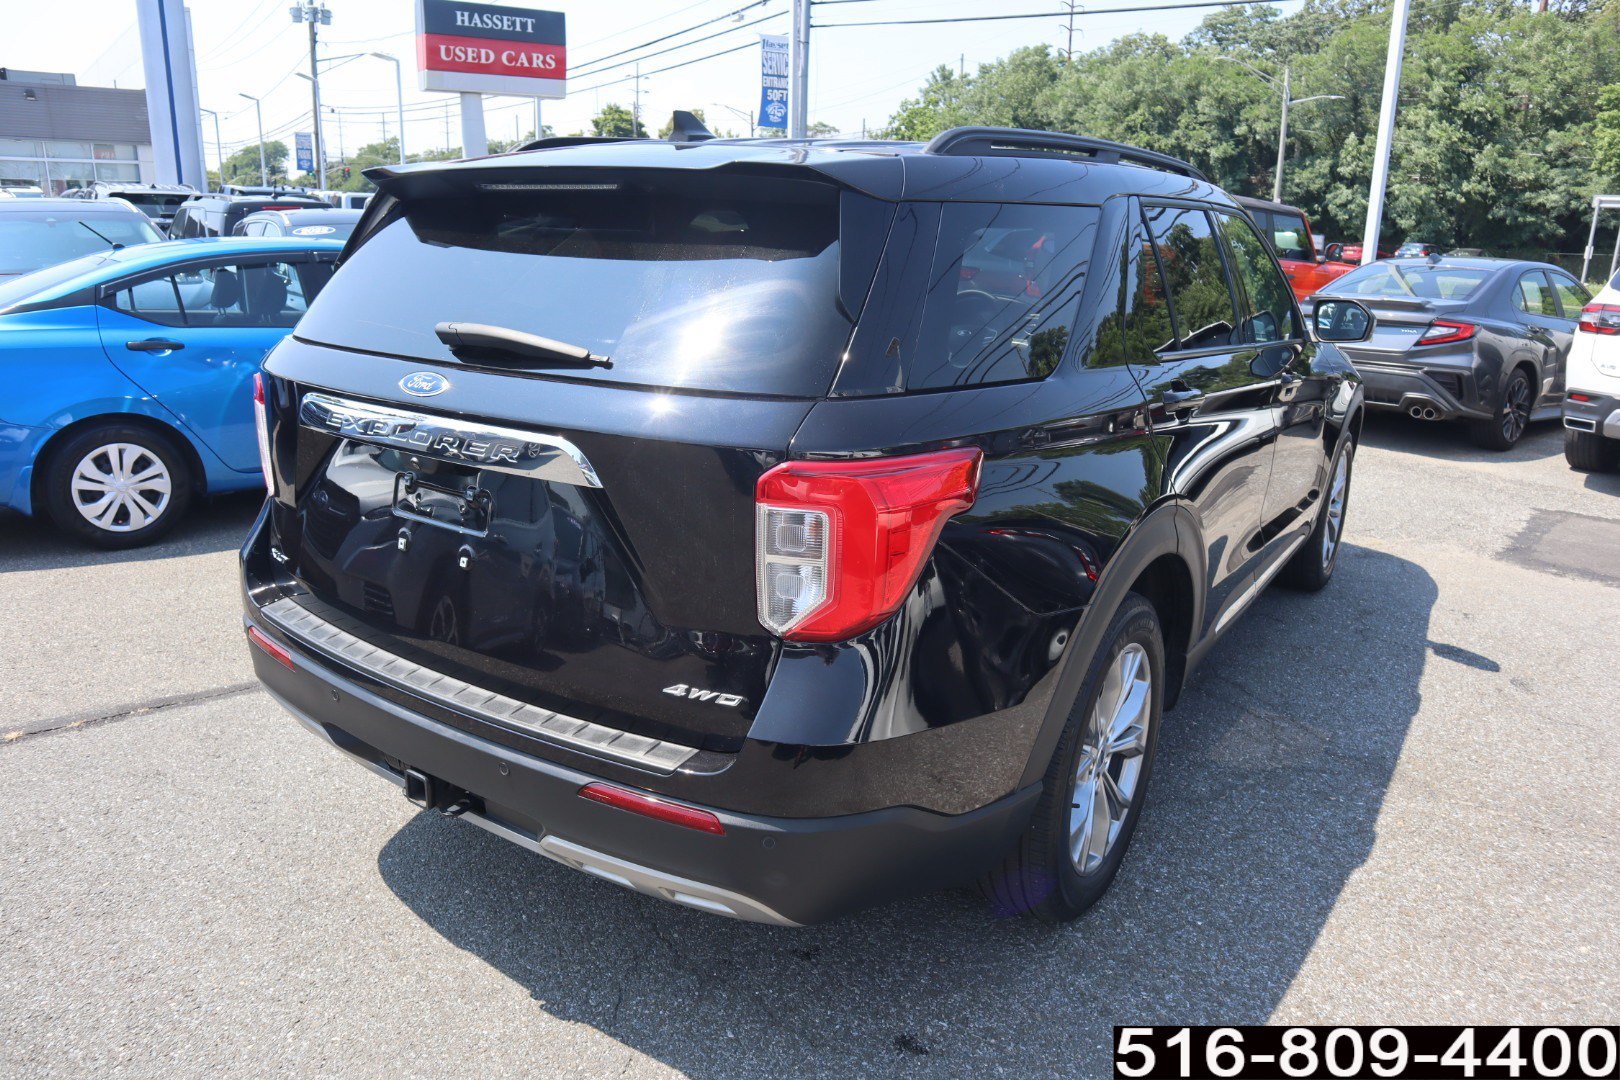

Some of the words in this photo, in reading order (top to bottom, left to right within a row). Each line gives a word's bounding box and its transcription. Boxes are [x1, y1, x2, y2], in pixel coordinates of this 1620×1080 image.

[455, 10, 535, 33] HASSETT
[439, 45, 495, 64] USED
[501, 50, 556, 69] CARS
[407, 375, 437, 391] Ford
[325, 411, 520, 463] EXPLORER
[662, 683, 743, 707] 4WD
